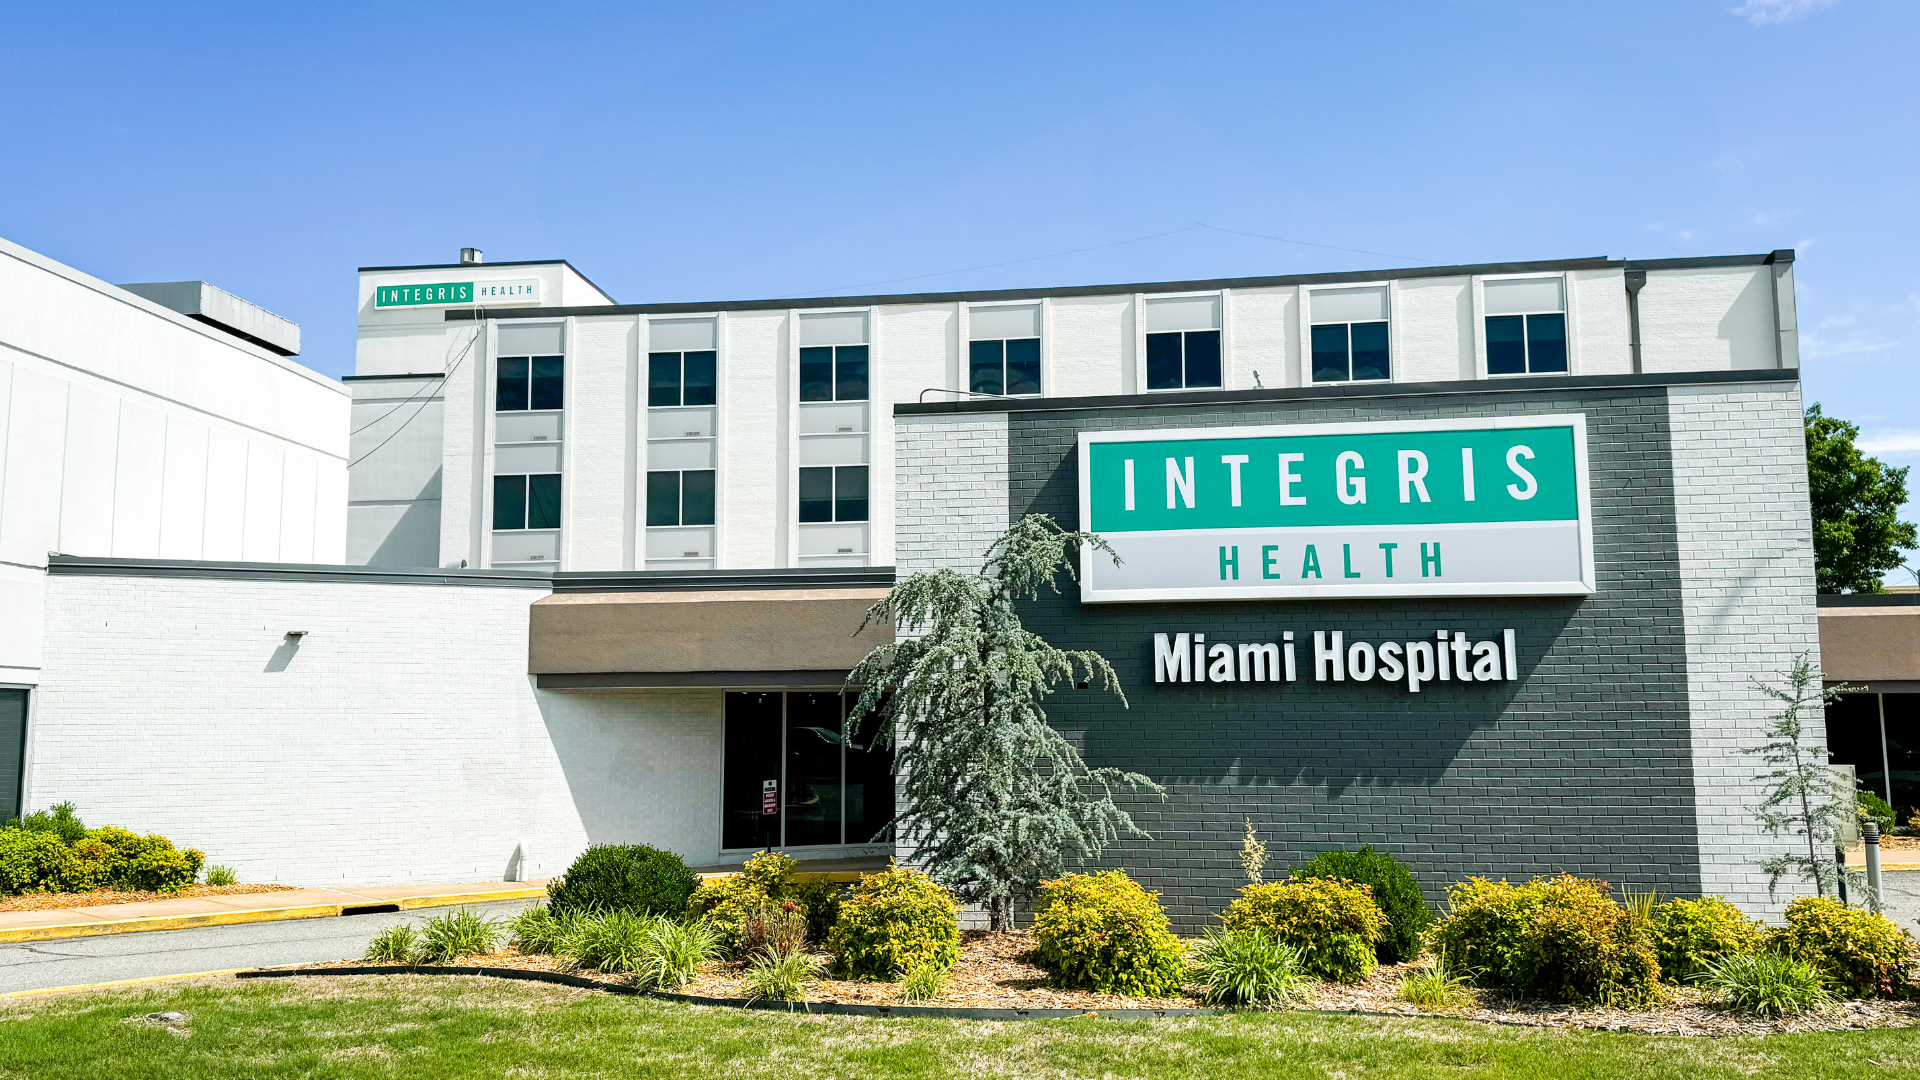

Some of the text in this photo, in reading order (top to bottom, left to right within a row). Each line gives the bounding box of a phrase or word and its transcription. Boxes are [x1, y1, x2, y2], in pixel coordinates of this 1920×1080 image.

[382, 285, 532, 302] INTEGRIS HEALTH
[1123, 444, 1539, 511] INTEGRIS
[1219, 541, 1443, 580] HEALTH
[1153, 628, 1518, 693] Miami Hospital
